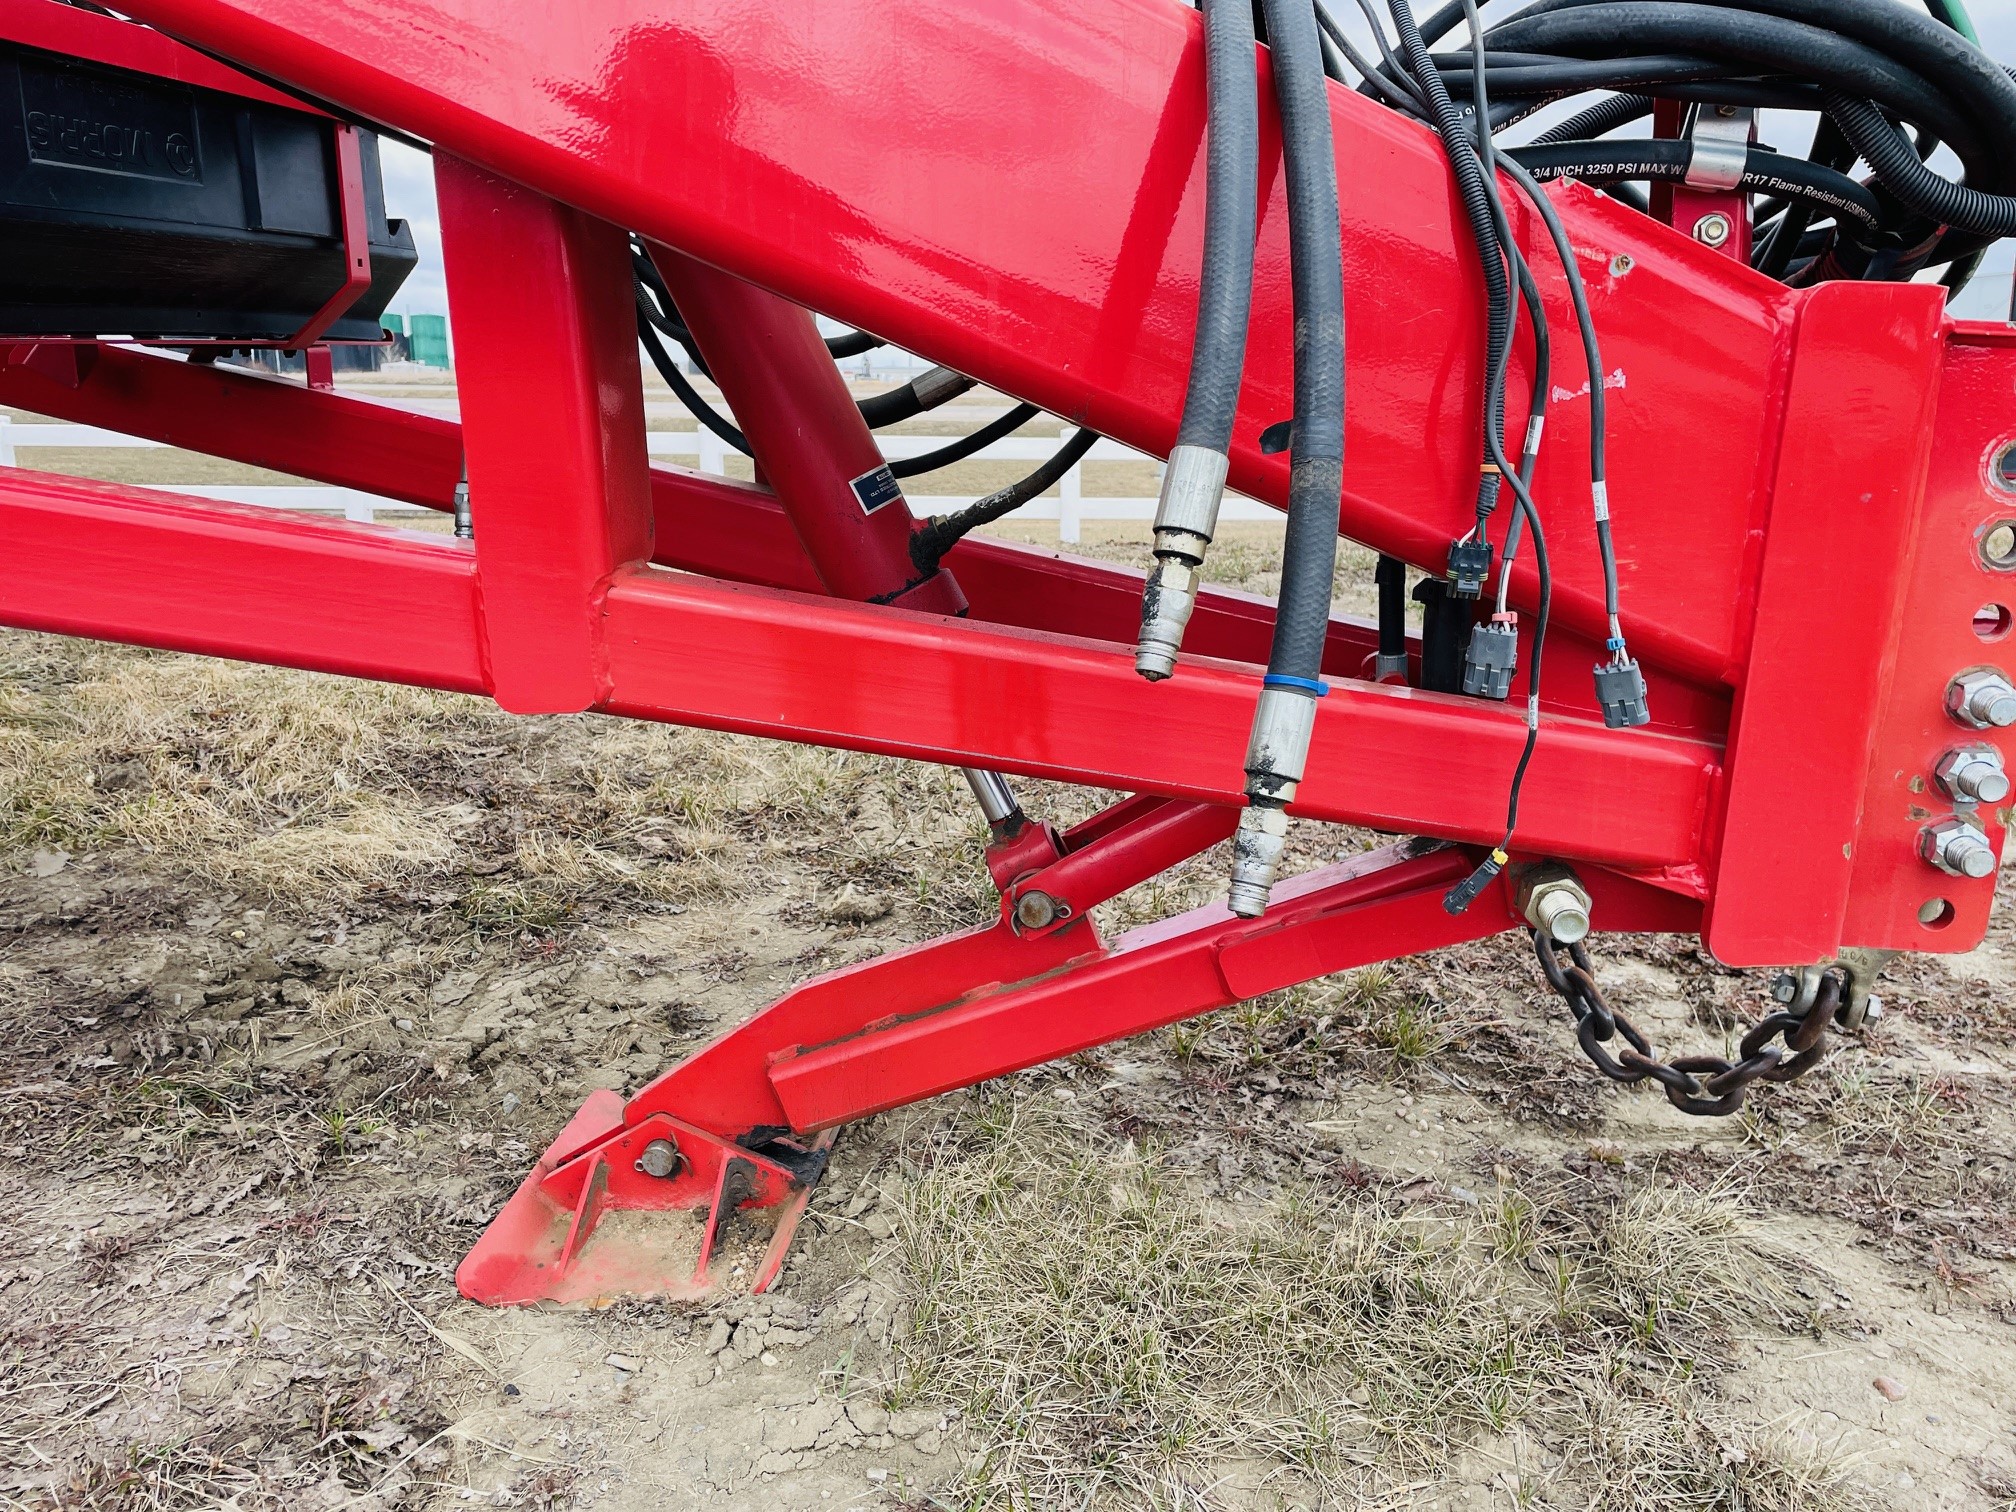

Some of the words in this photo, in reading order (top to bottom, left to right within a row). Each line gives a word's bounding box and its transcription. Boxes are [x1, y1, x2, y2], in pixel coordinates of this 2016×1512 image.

[28, 111, 154, 167] MORRIS
[1533, 167, 1550, 178] 3/4
[1553, 165, 1583, 176] INCH
[1586, 163, 1614, 174] 3250
[1616, 163, 1637, 174] PSI
[1639, 163, 1667, 174] MAX
[1768, 177, 1803, 193] Flame
[1803, 185, 1846, 208] Resistant
